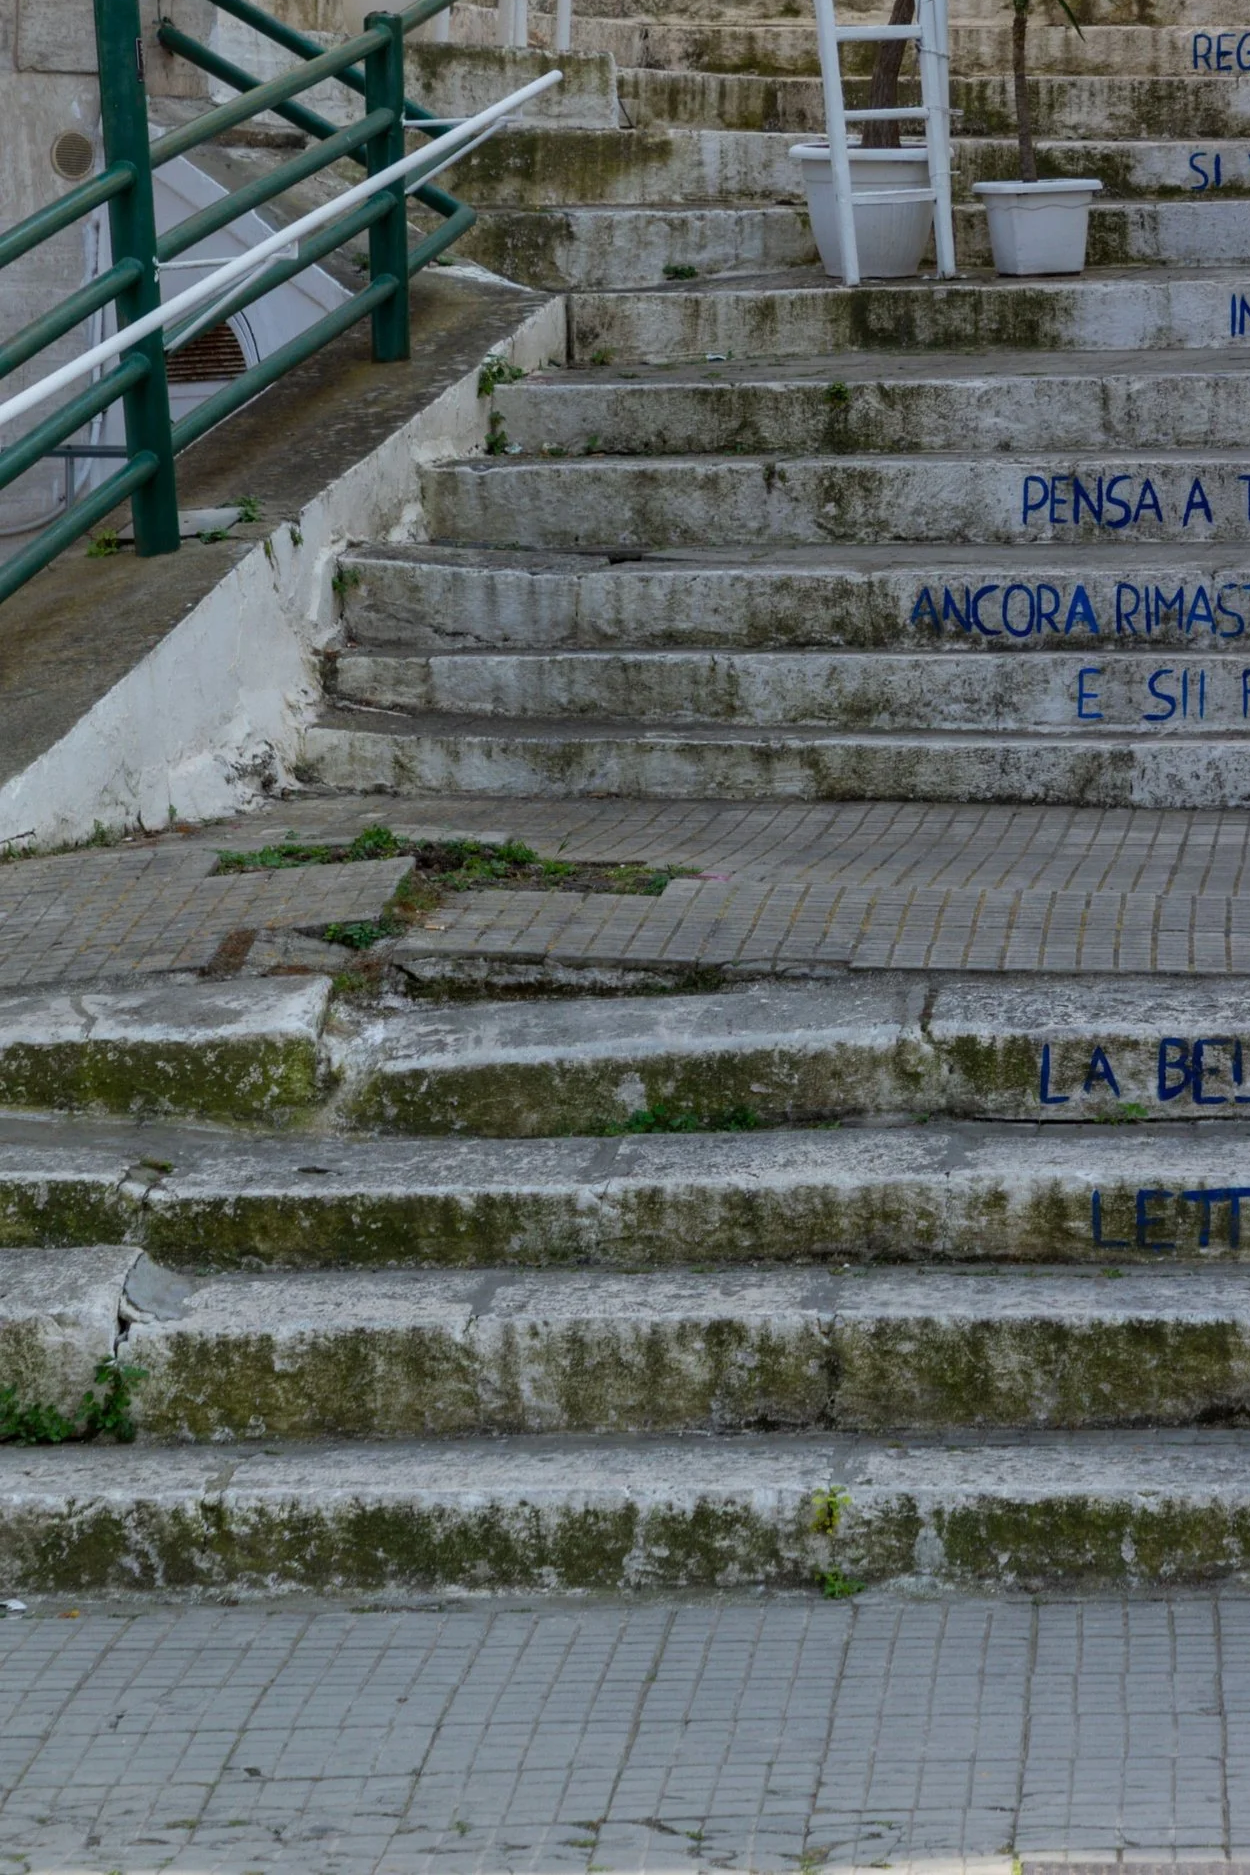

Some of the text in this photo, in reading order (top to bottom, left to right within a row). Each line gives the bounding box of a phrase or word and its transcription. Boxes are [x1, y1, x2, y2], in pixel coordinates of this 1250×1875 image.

[1189, 152, 1222, 191] SI
[1022, 475, 1163, 529] PENSA
[1183, 477, 1213, 527] A
[910, 583, 1099, 638] ANCORA
[1077, 667, 1104, 720] E
[1143, 668, 1206, 721] SII
[1039, 1042, 1120, 1105] LA
